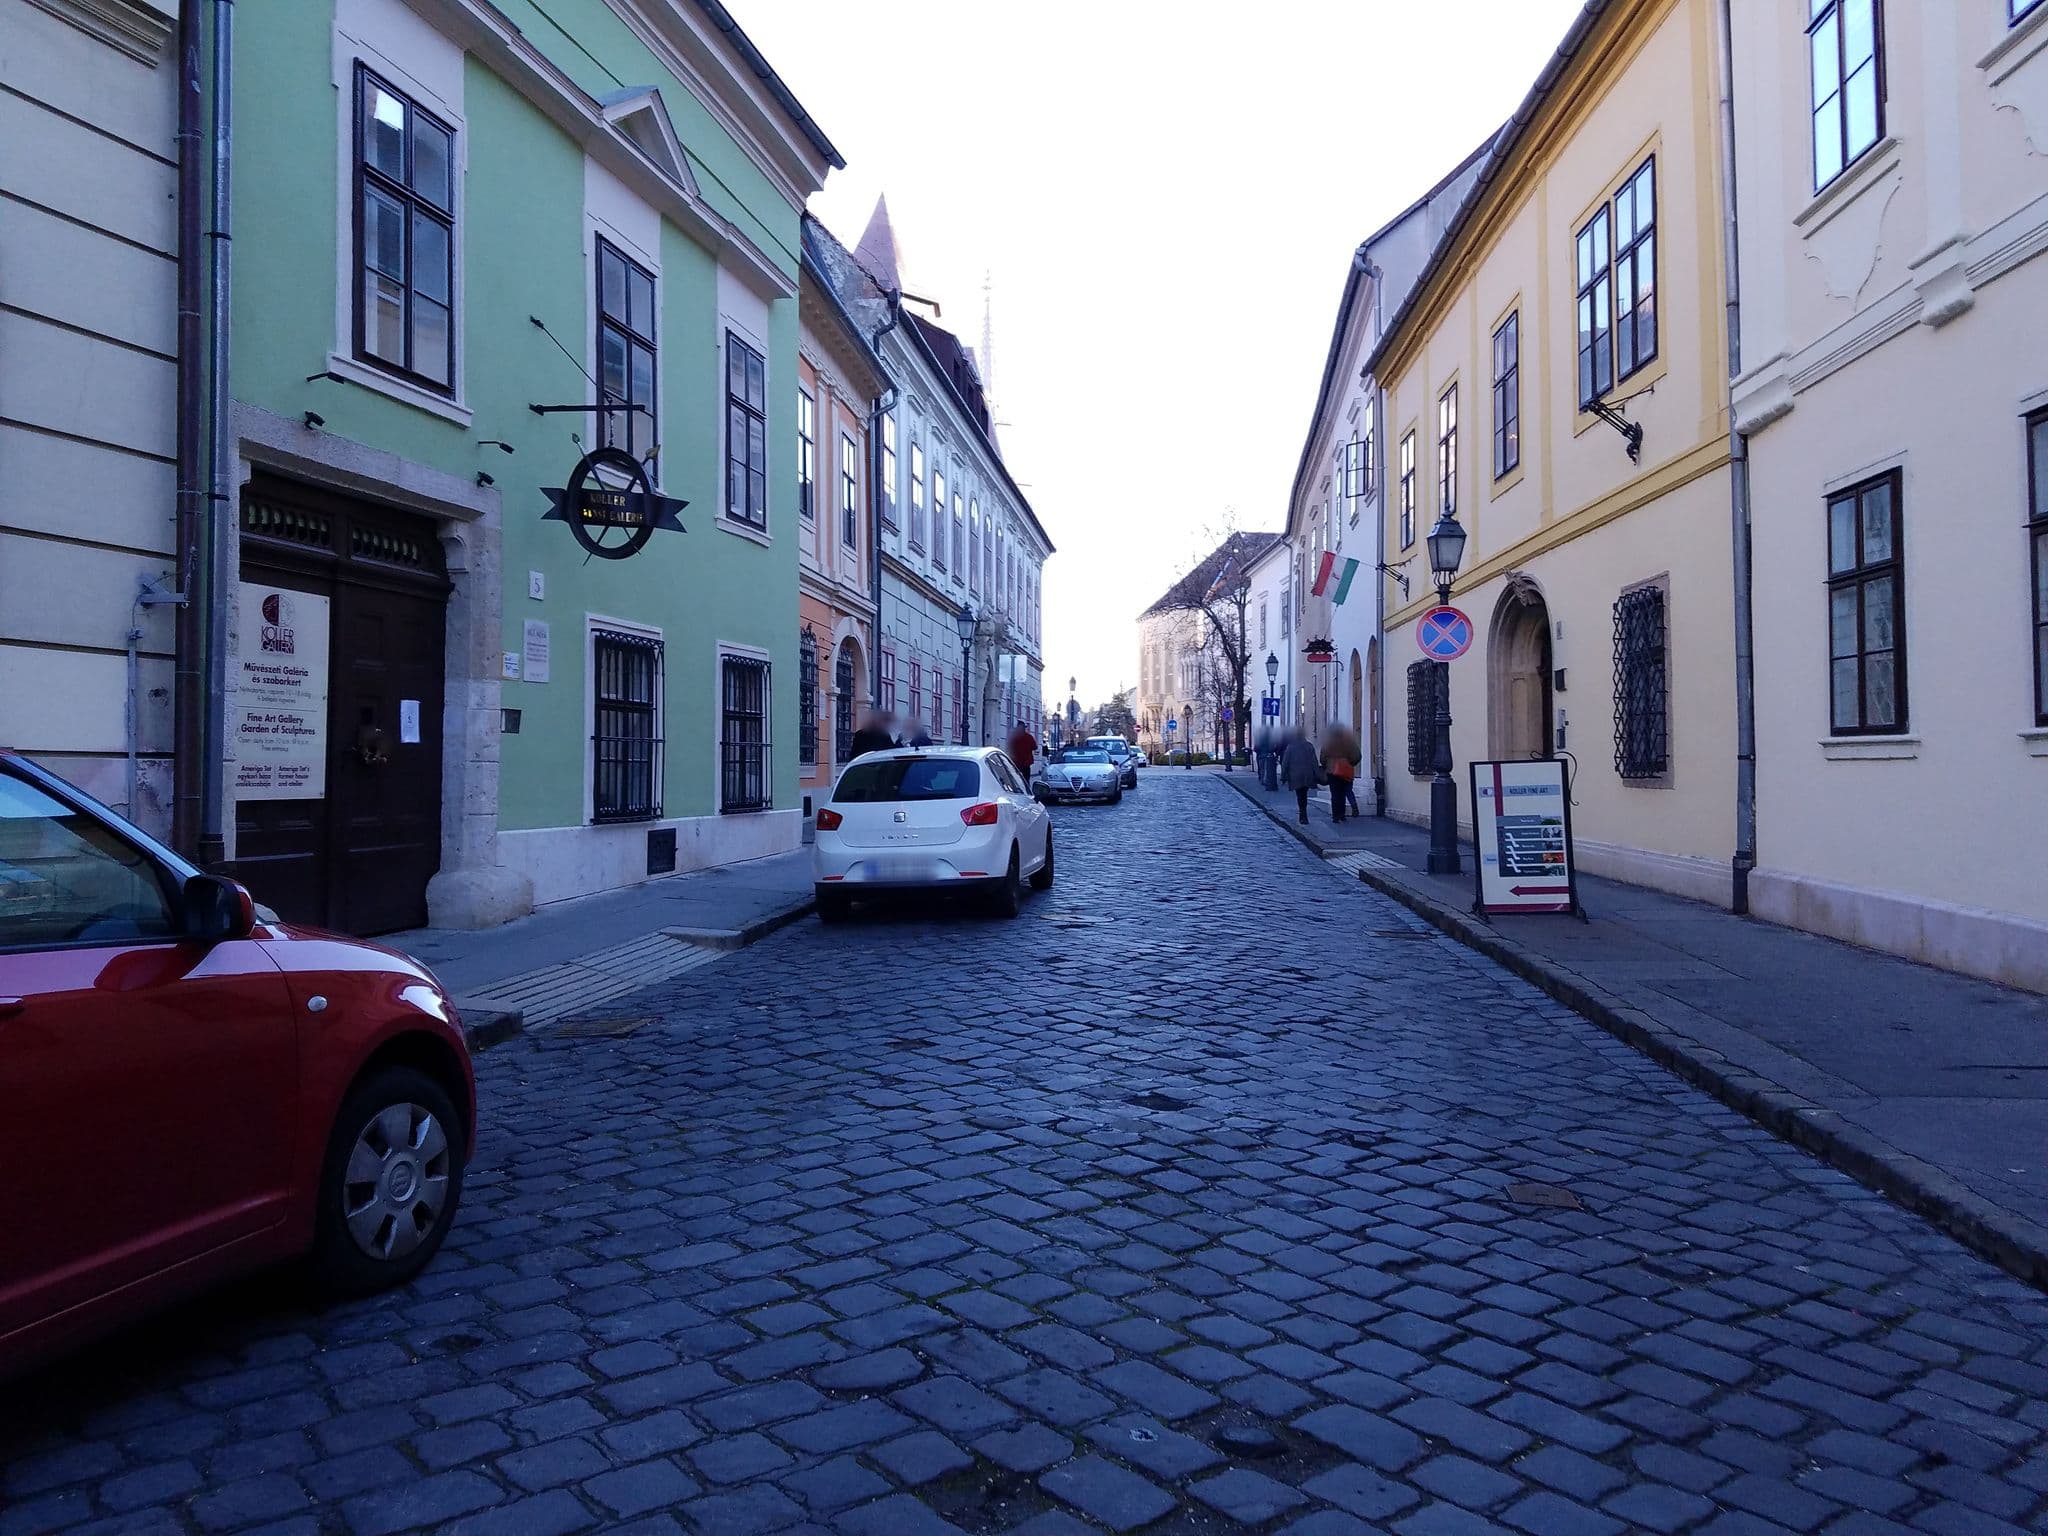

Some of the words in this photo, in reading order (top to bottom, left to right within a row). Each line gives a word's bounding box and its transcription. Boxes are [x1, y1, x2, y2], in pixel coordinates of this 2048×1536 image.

[533, 577, 541, 593] 5
[261, 625, 294, 643] KOLLER
[247, 712, 263, 722] Fine
[264, 714, 276, 723] Art
[278, 714, 304, 726] Gallery
[241, 723, 270, 734] Garden
[271, 724, 280, 734] of
[281, 726, 316, 737] Sculptures
